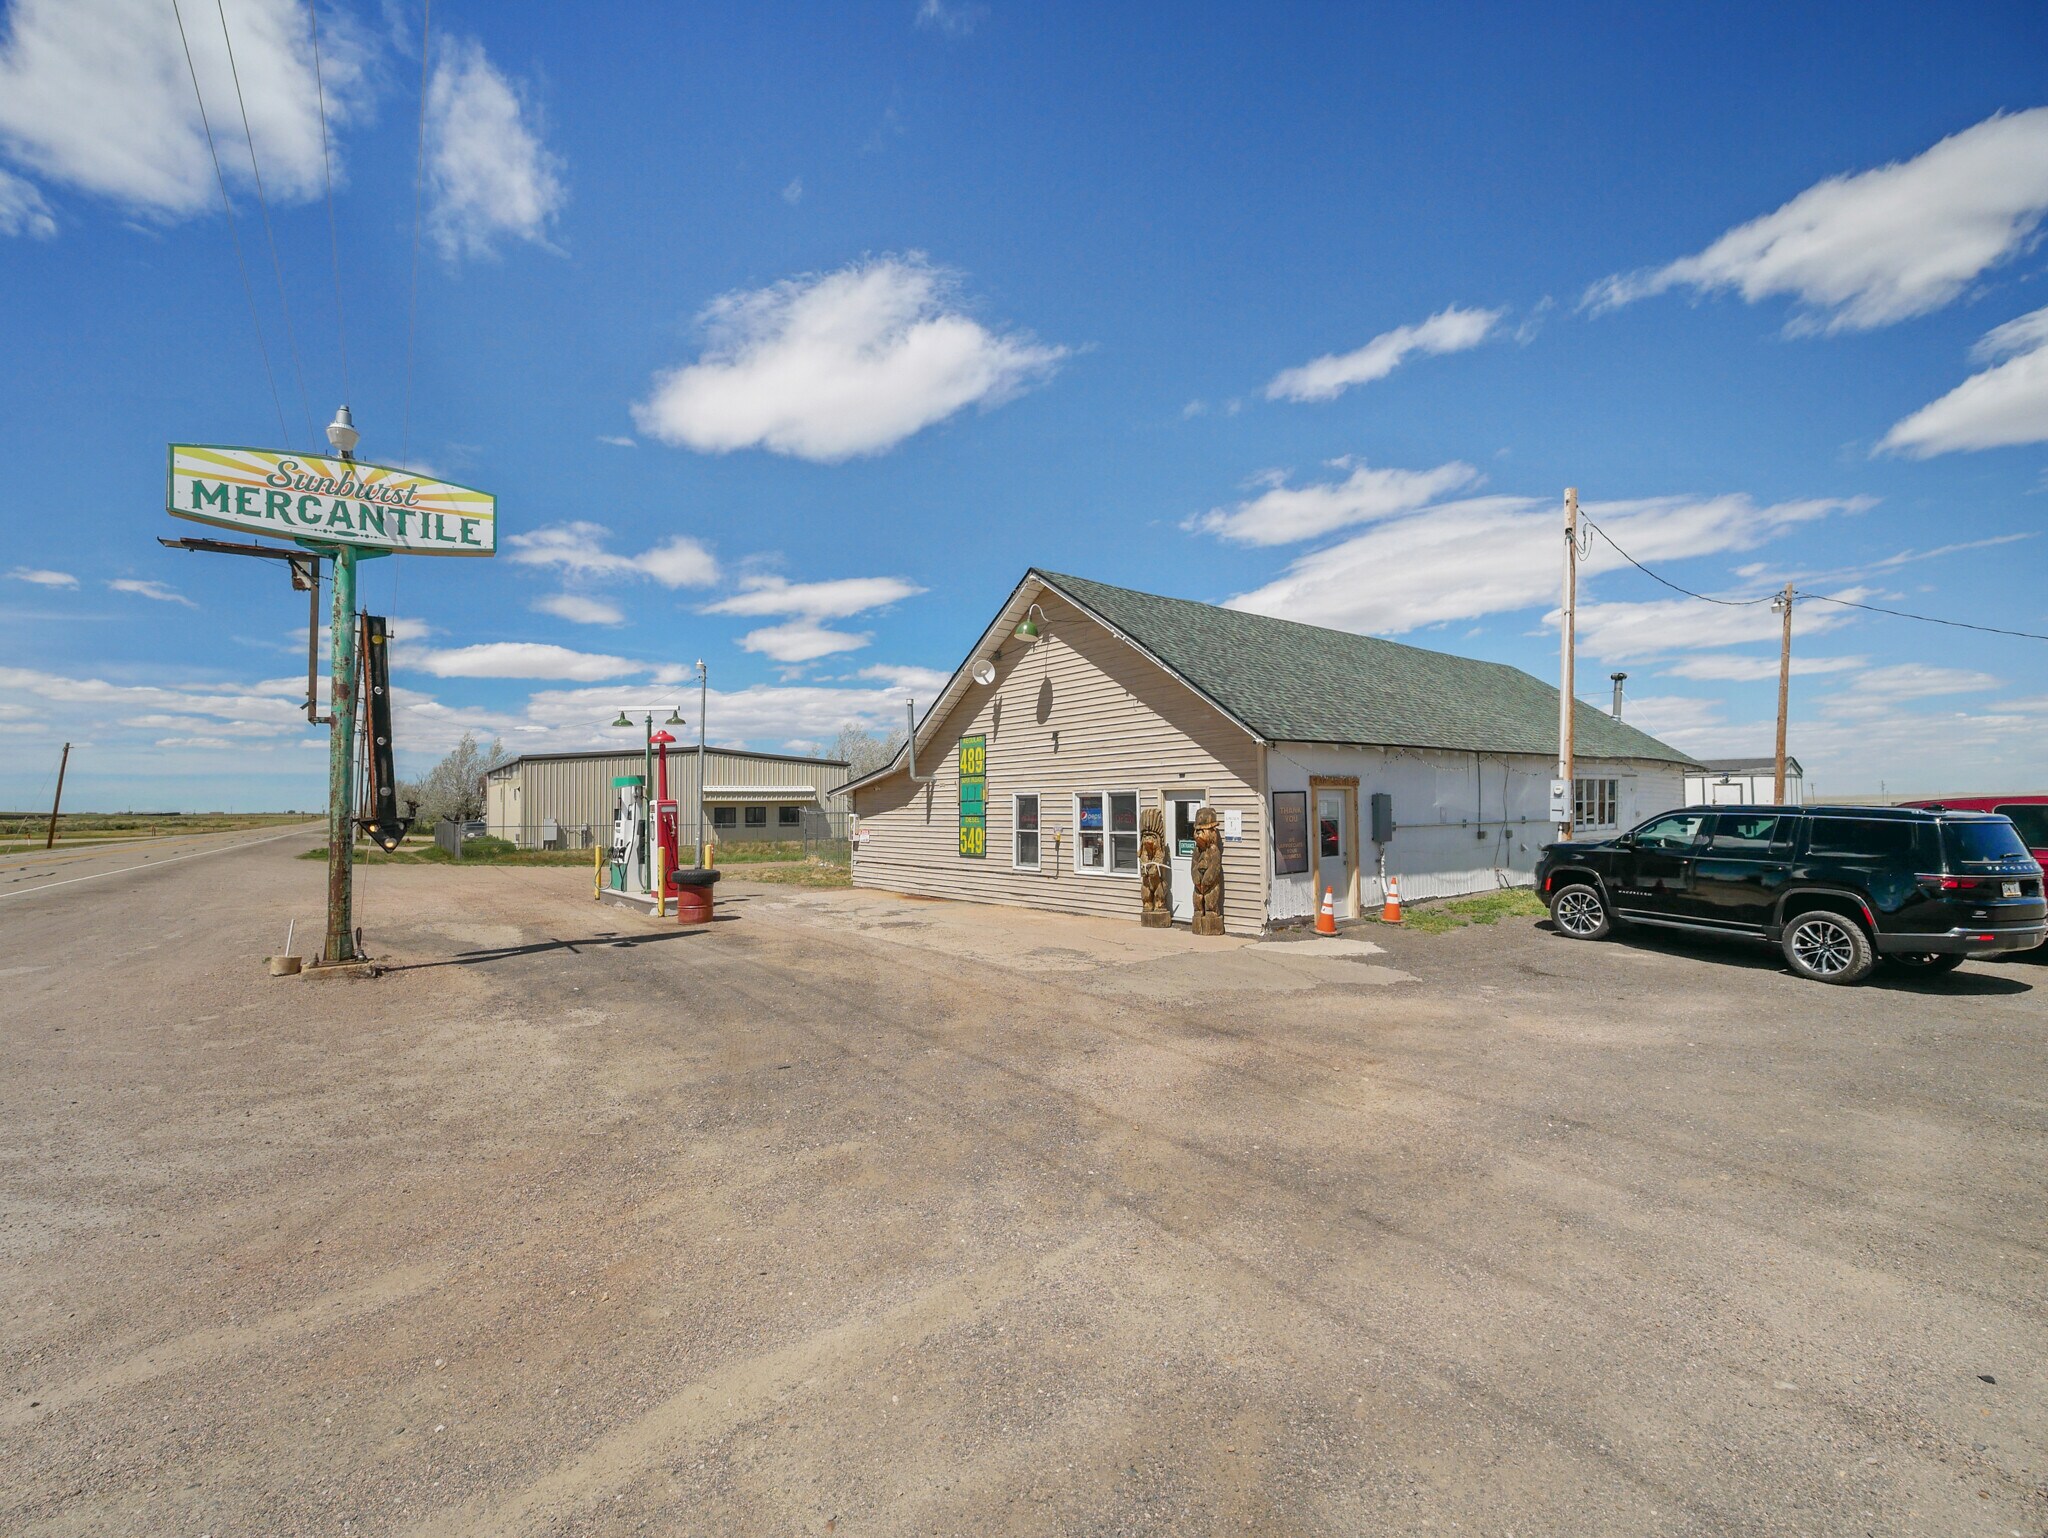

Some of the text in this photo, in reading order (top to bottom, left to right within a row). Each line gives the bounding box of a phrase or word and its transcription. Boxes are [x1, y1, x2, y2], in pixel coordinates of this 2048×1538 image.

[266, 459, 421, 506] Sunburst
[191, 479, 482, 545] MERCANTILE
[963, 736, 983, 744] REGULAR
[960, 747, 983, 774] 489
[1087, 813, 1102, 821] pepsi
[1279, 807, 1302, 815] THANK
[1285, 815, 1298, 823] YOU
[960, 827, 983, 854] 549
